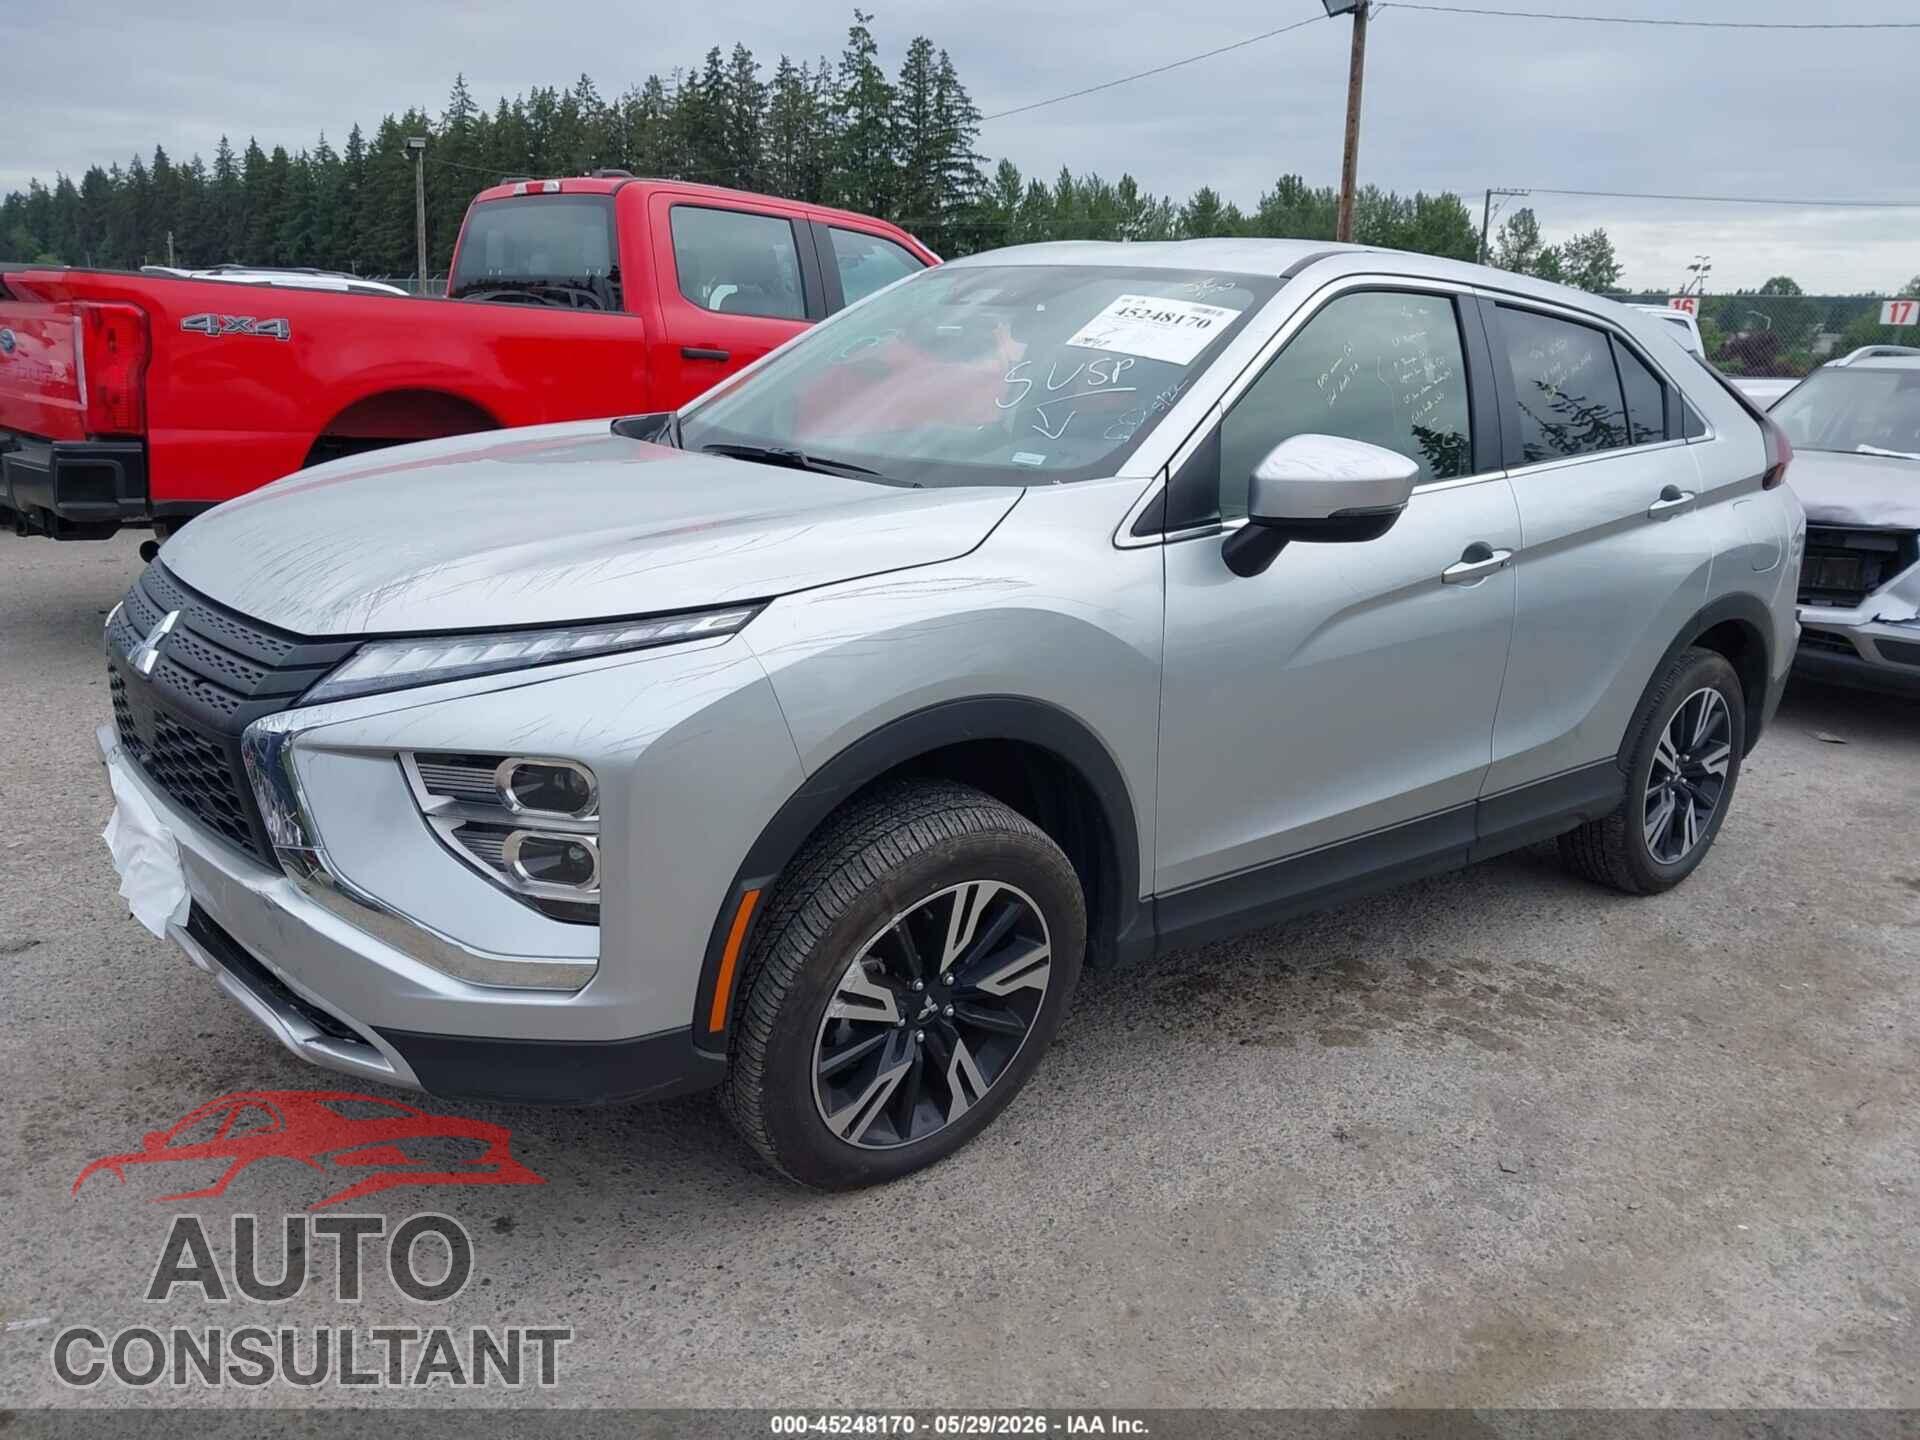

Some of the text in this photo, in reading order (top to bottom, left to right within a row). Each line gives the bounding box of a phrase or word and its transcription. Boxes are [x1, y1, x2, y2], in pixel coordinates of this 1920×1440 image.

[1115, 306, 1212, 329] 45248170
[1673, 299, 1694, 315] 16
[1889, 302, 1912, 323] 17
[995, 357, 1135, 408] SUSP
